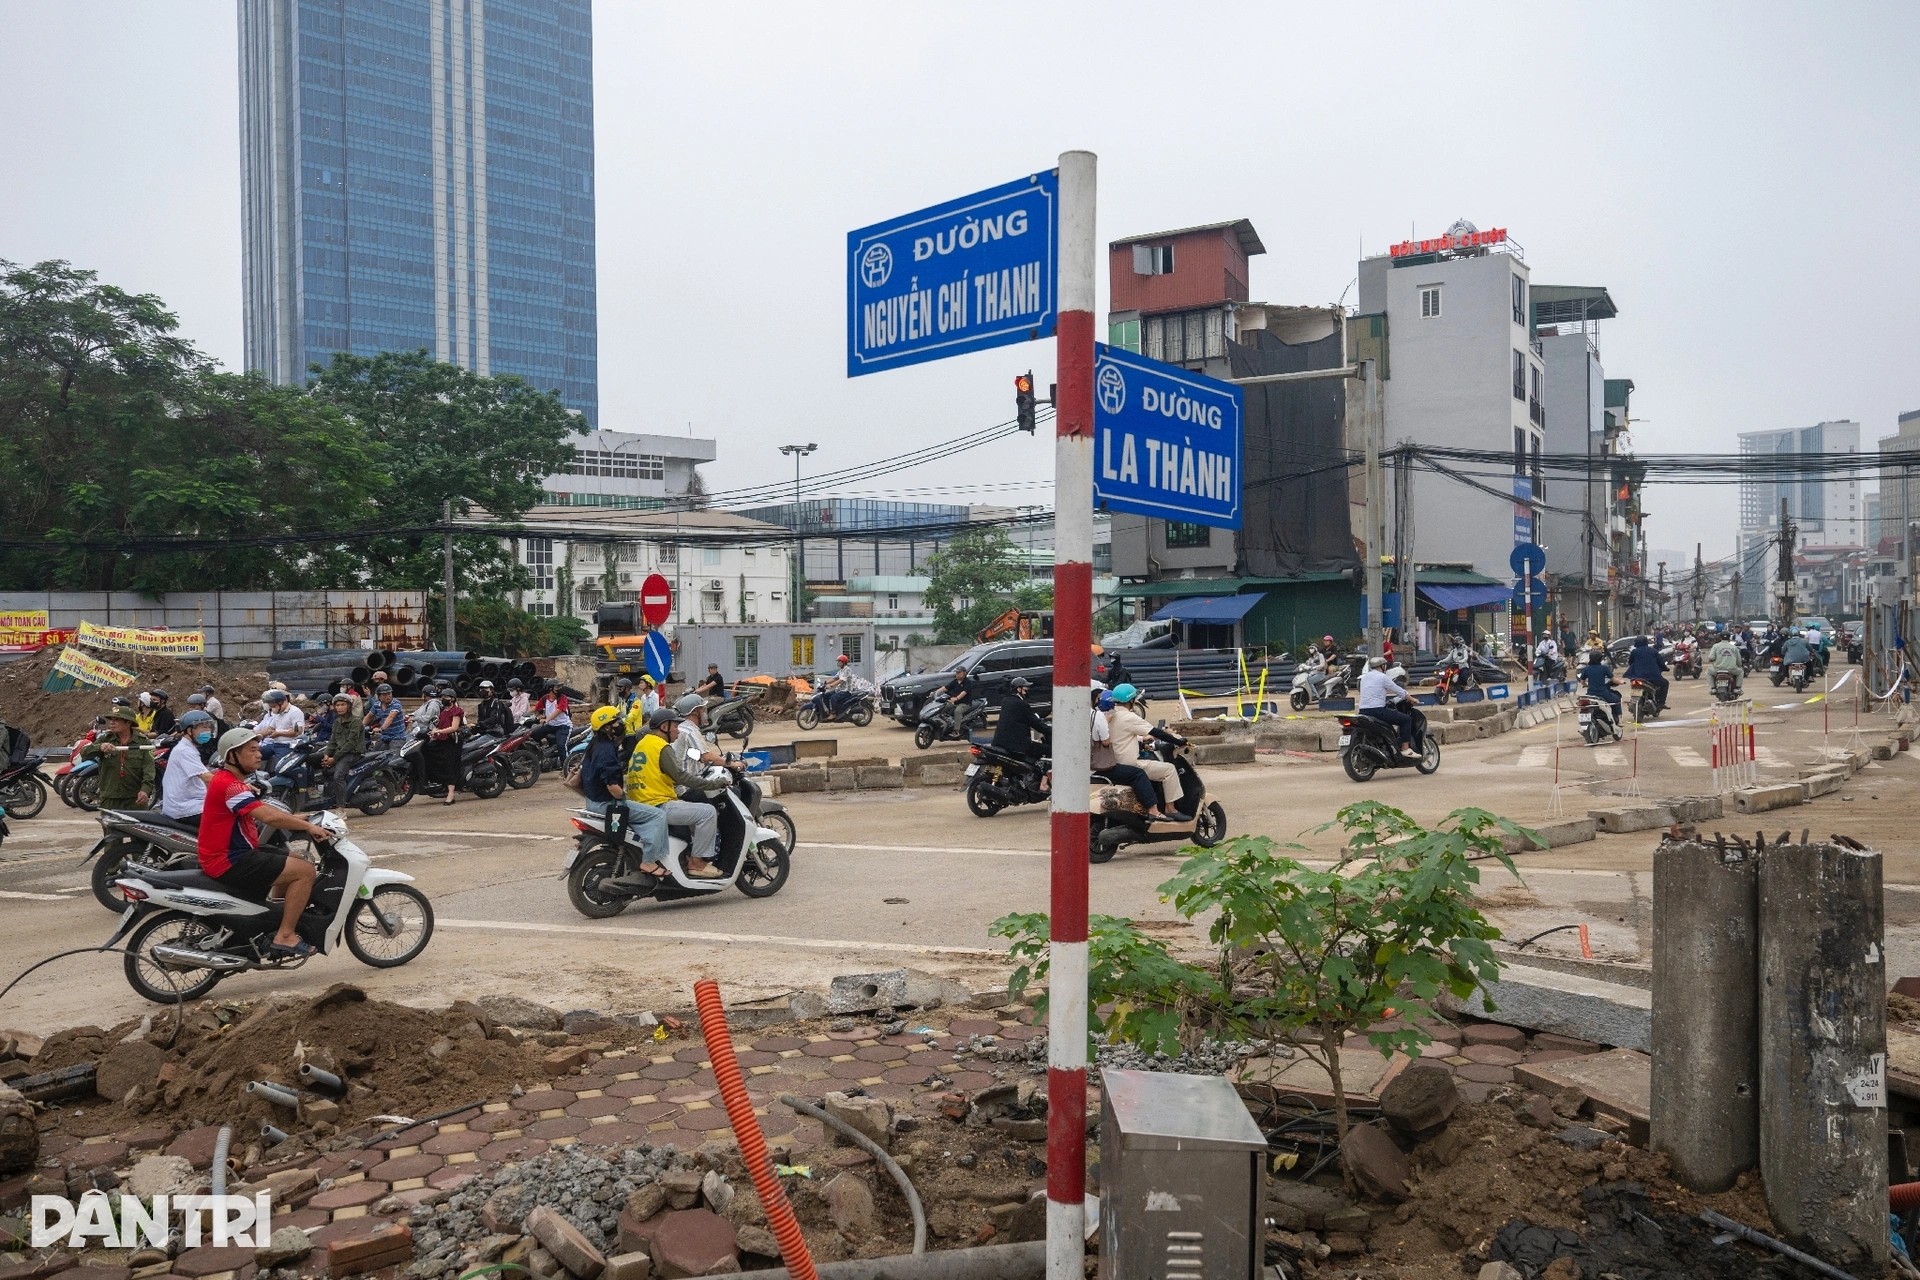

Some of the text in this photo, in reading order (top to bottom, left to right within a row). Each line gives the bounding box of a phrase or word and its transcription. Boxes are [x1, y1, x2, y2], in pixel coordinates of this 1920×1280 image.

[913, 210, 1028, 262] ĐƯỜNG
[864, 262, 1040, 349] NGUYỄN CHÍ THANH
[1142, 386, 1222, 430] ĐƯỜNG
[1102, 428, 1231, 502] LA THÀNH
